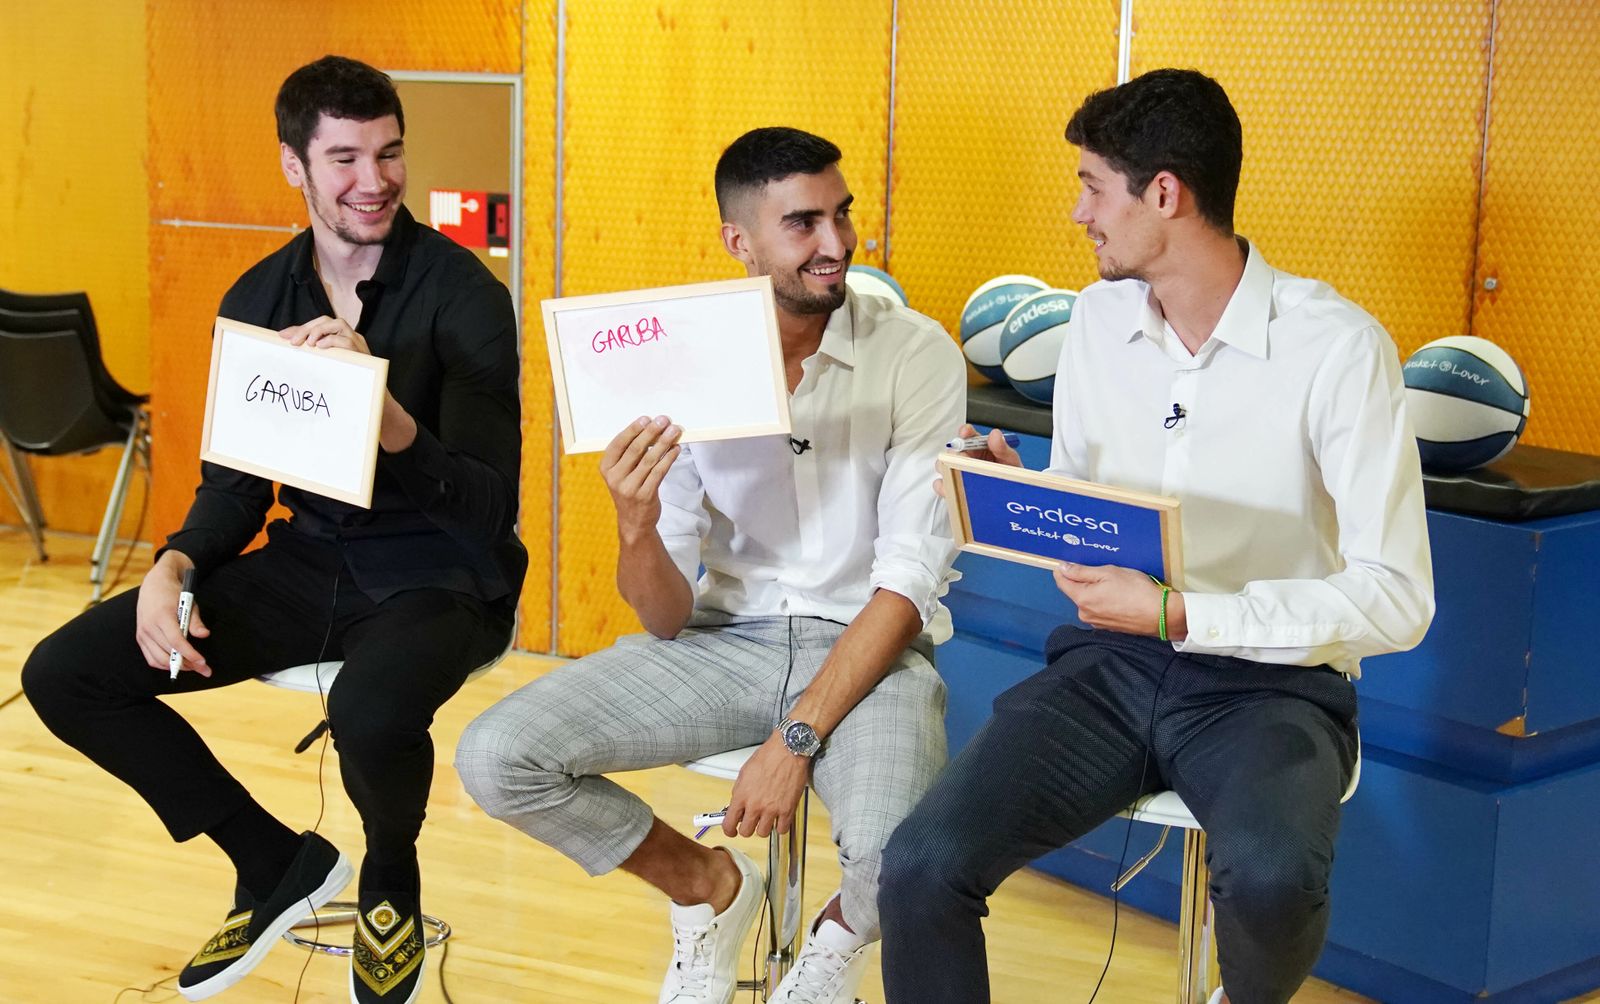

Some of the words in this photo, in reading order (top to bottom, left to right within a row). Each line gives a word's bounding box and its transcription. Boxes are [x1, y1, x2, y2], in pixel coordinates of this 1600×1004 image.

[1009, 298, 1070, 334] endesa
[591, 316, 668, 354] GARUBA
[1451, 363, 1490, 386] Lover
[245, 374, 331, 418] GARUBA
[1006, 501, 1119, 535] endesa
[1009, 521, 1061, 540] Basket
[1081, 537, 1120, 552] Lover
